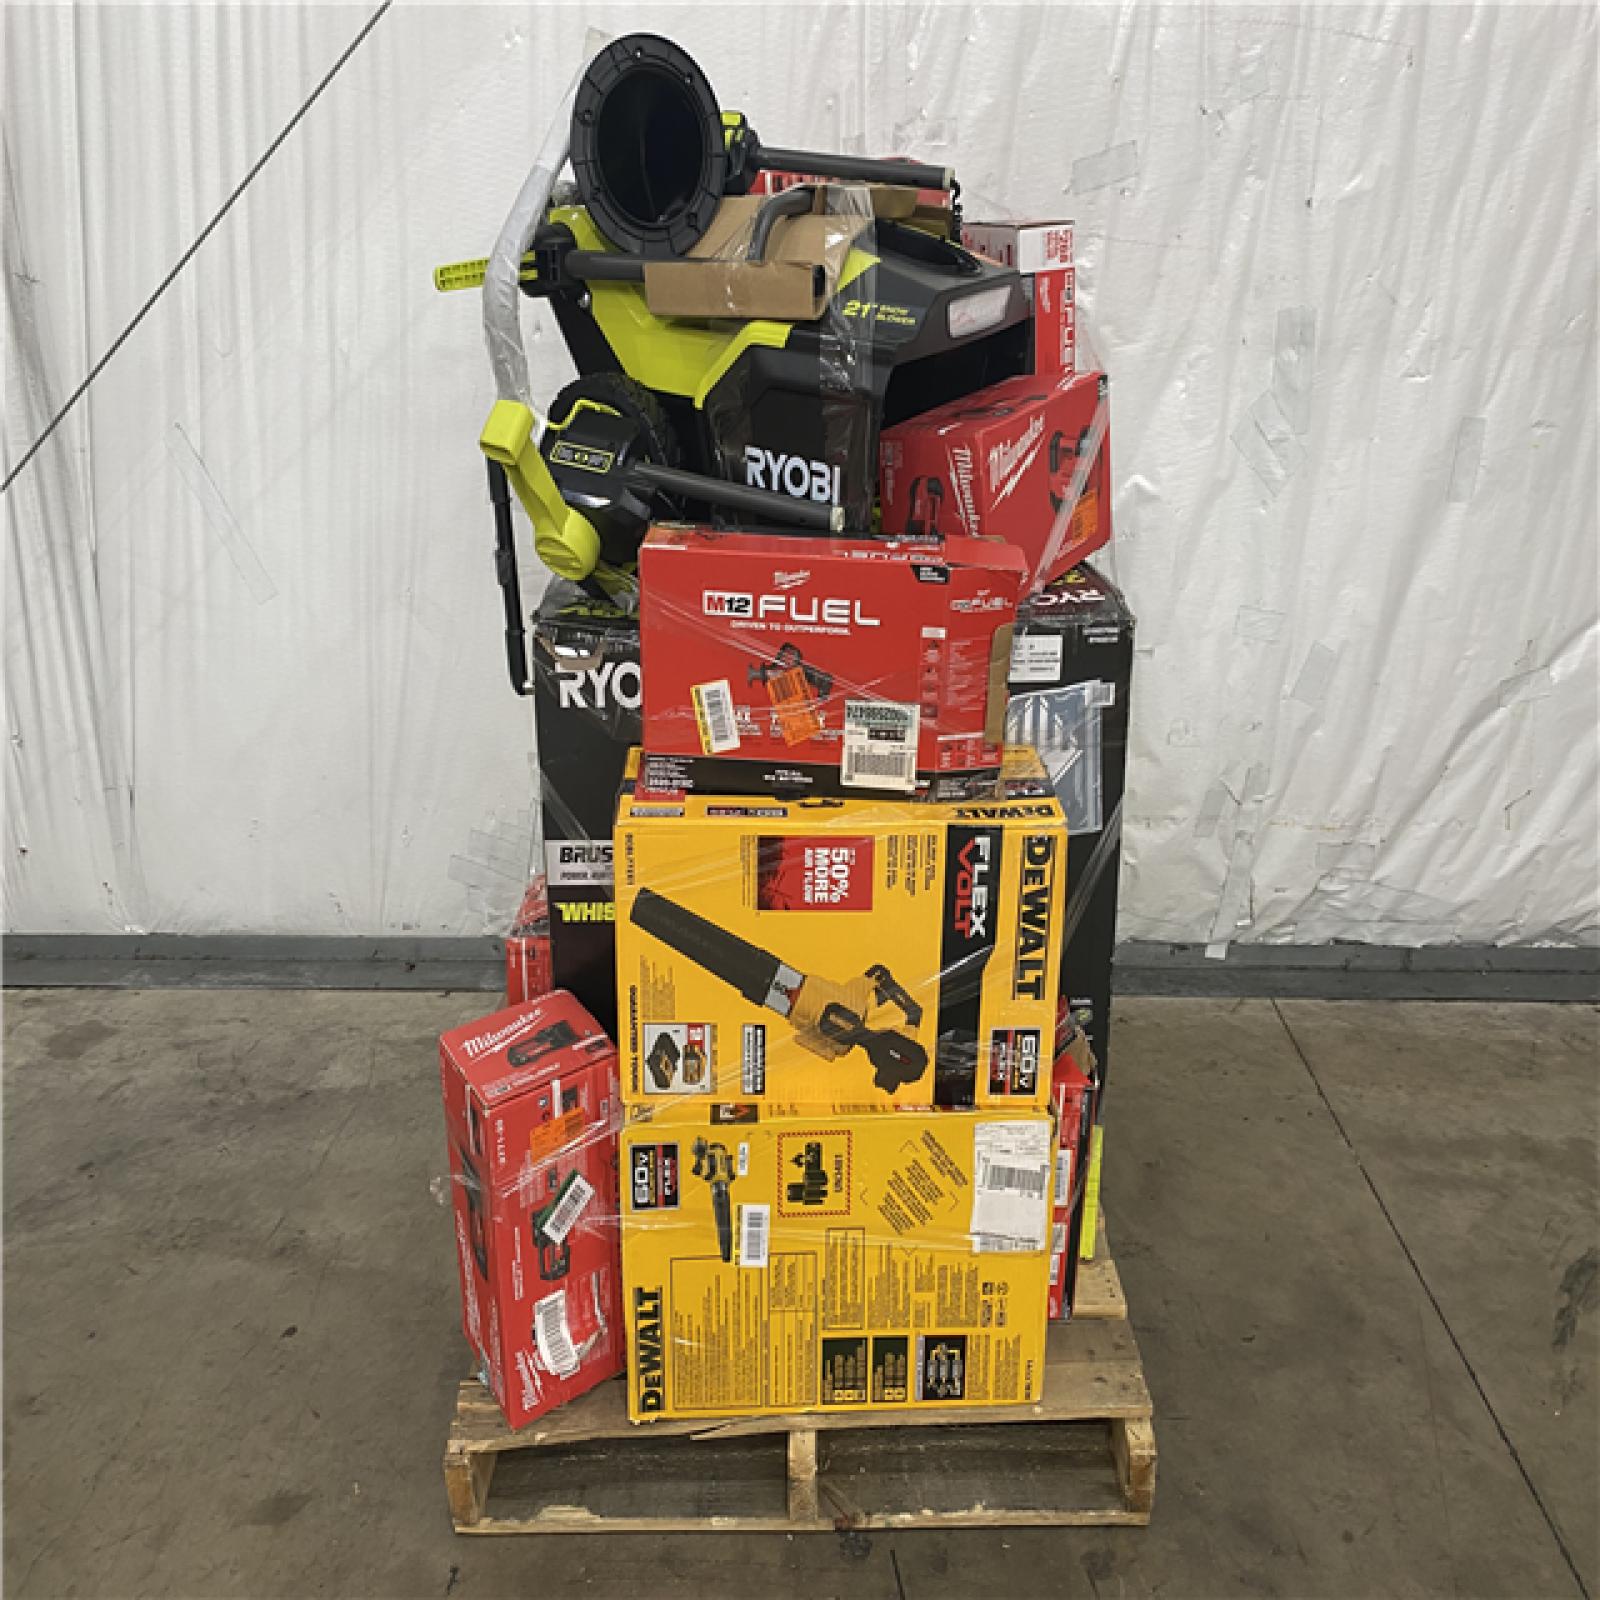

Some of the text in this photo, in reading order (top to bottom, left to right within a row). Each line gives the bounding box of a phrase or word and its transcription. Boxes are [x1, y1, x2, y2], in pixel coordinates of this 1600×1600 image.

[744, 445, 841, 507] RYOBI
[705, 592, 881, 626] M12 FUEL
[814, 847, 830, 903] MORE
[830, 847, 849, 904] 50%
[954, 838, 975, 940] VOLT
[970, 836, 991, 938] FLEX
[1013, 834, 1052, 1001] DEWALT
[464, 1008, 541, 1058] Milwaukee
[630, 1286, 664, 1414] DEWALT
